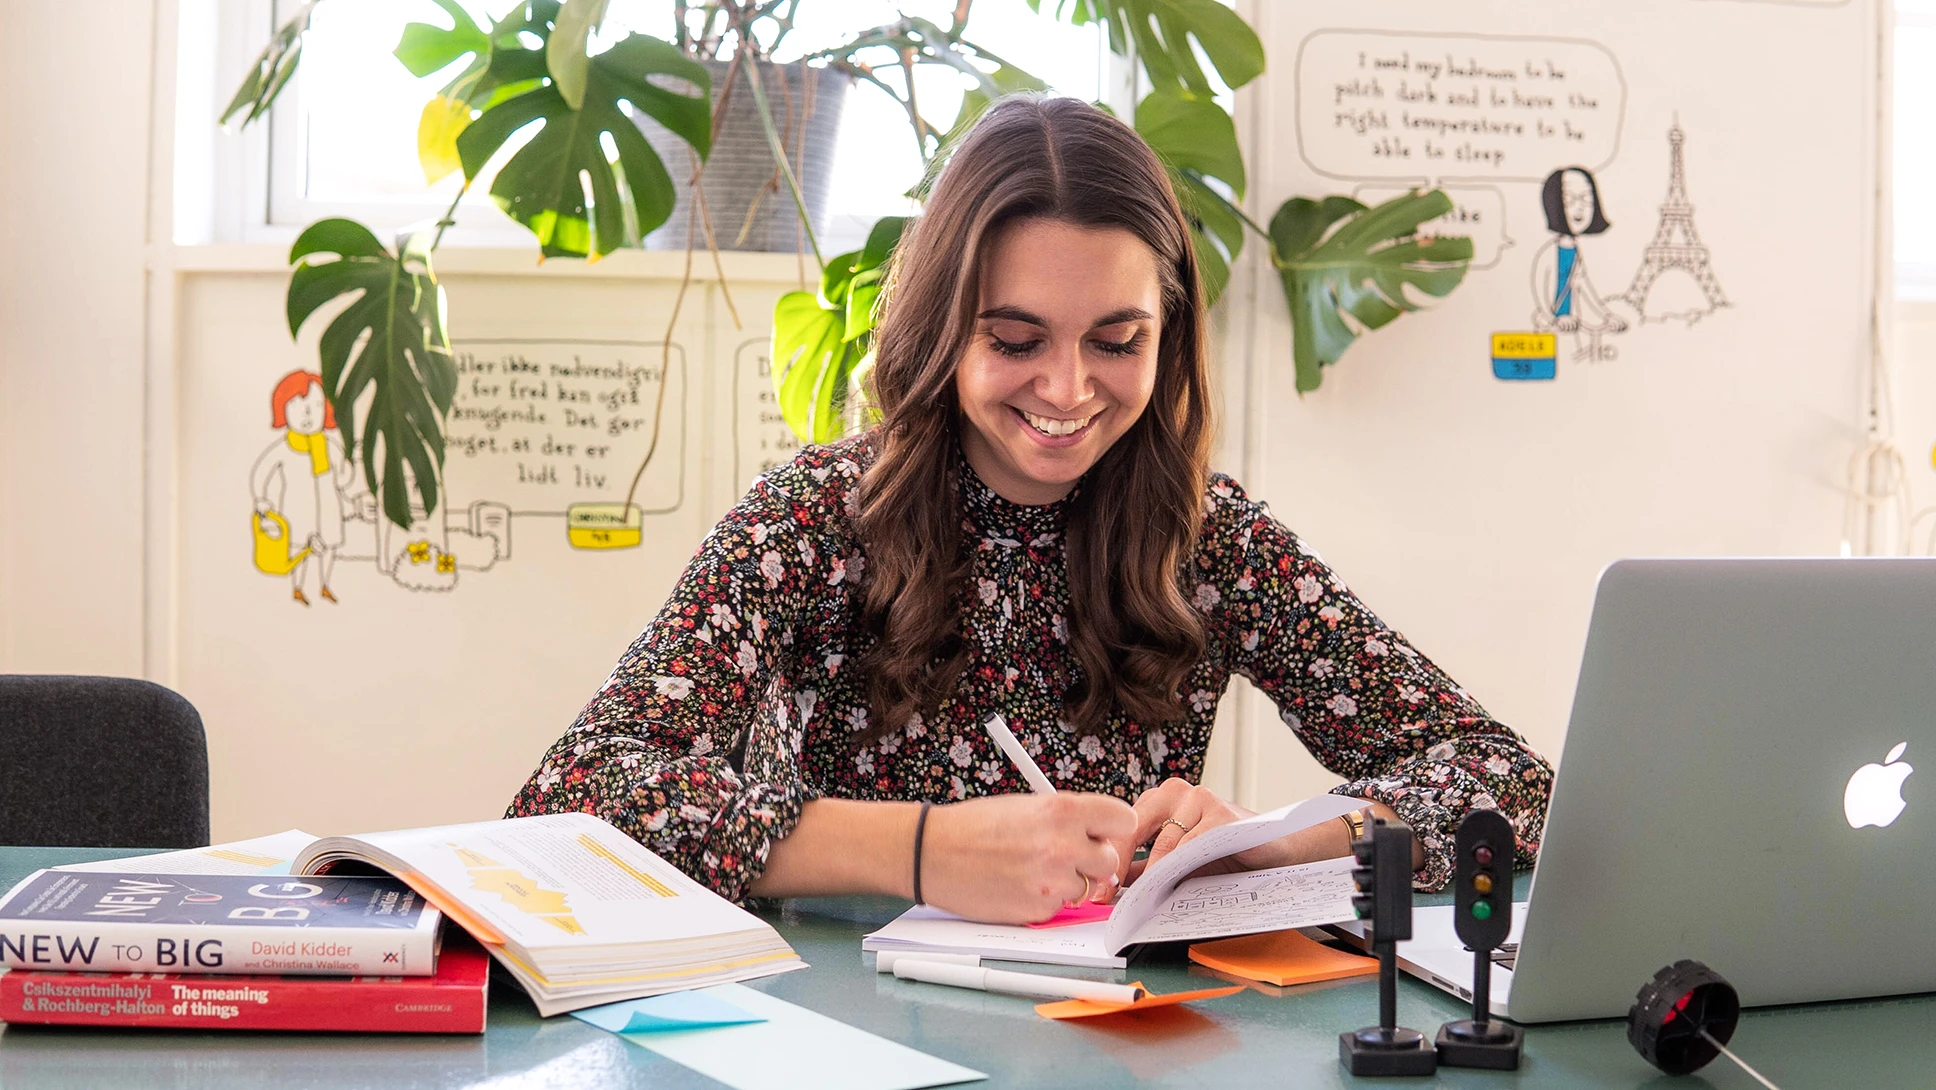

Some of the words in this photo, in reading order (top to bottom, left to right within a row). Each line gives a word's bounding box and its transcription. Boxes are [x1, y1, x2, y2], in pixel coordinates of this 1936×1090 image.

[1359, 51, 1366, 69] I
[1374, 50, 1409, 70] need
[1416, 62, 1441, 80] my
[1525, 59, 1541, 79] to
[1546, 58, 1565, 80] be
[1335, 77, 1384, 105] pitch
[1397, 79, 1437, 103] dark
[1447, 85, 1479, 107] and
[1490, 86, 1506, 108] to
[1512, 86, 1554, 109] have
[1568, 92, 1598, 108] the
[1335, 107, 1389, 136] right
[1402, 109, 1523, 137] temperature
[1537, 117, 1555, 139] to
[1563, 119, 1584, 142] be
[1372, 136, 1411, 159] able
[1425, 139, 1444, 159] to
[1455, 142, 1504, 167] sleep
[564, 408, 599, 429] Det
[512, 436, 530, 453] at
[541, 433, 576, 456] der
[585, 445, 610, 458] er
[517, 462, 559, 485] lidt
[83, 879, 175, 917] NEW
[0, 934, 100, 965] NEW
[112, 944, 143, 961] TO
[157, 938, 223, 967] BIG
[252, 941, 296, 956] David
[301, 942, 352, 957] Kidder
[244, 960, 260, 969] and
[262, 959, 313, 970] Christina
[316, 960, 360, 970] Wallace
[22, 981, 152, 1001] Csikszentmihalyi
[171, 985, 200, 1000] The
[202, 986, 269, 1004] meaning
[22, 998, 35, 1012] &
[172, 1002, 190, 1016] of
[191, 1002, 239, 1019] things
